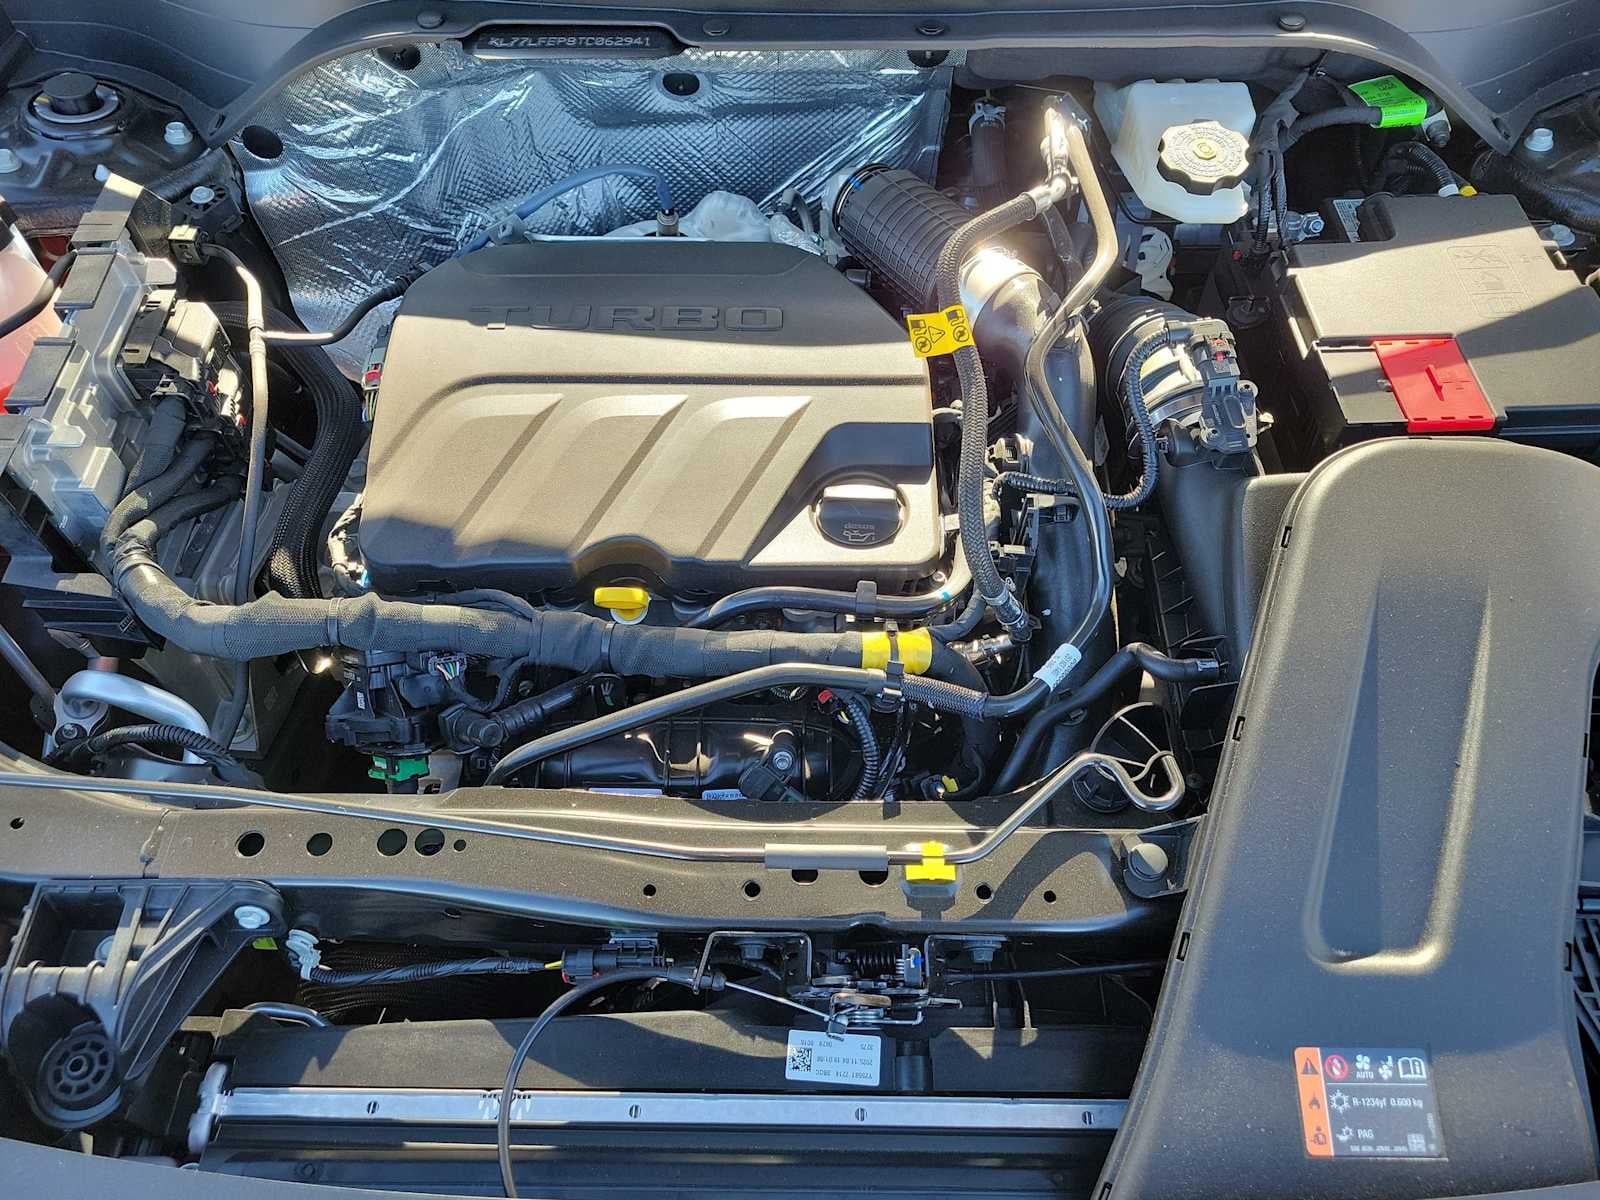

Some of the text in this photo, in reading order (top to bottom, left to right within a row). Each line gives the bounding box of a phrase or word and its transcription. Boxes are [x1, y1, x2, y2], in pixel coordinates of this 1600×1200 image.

[487, 36, 651, 47] KL77LFEP8TC062941
[470, 304, 784, 331] TURBO
[1356, 1071, 1374, 1080] AUTO
[1357, 1128, 1375, 1140] PAG
